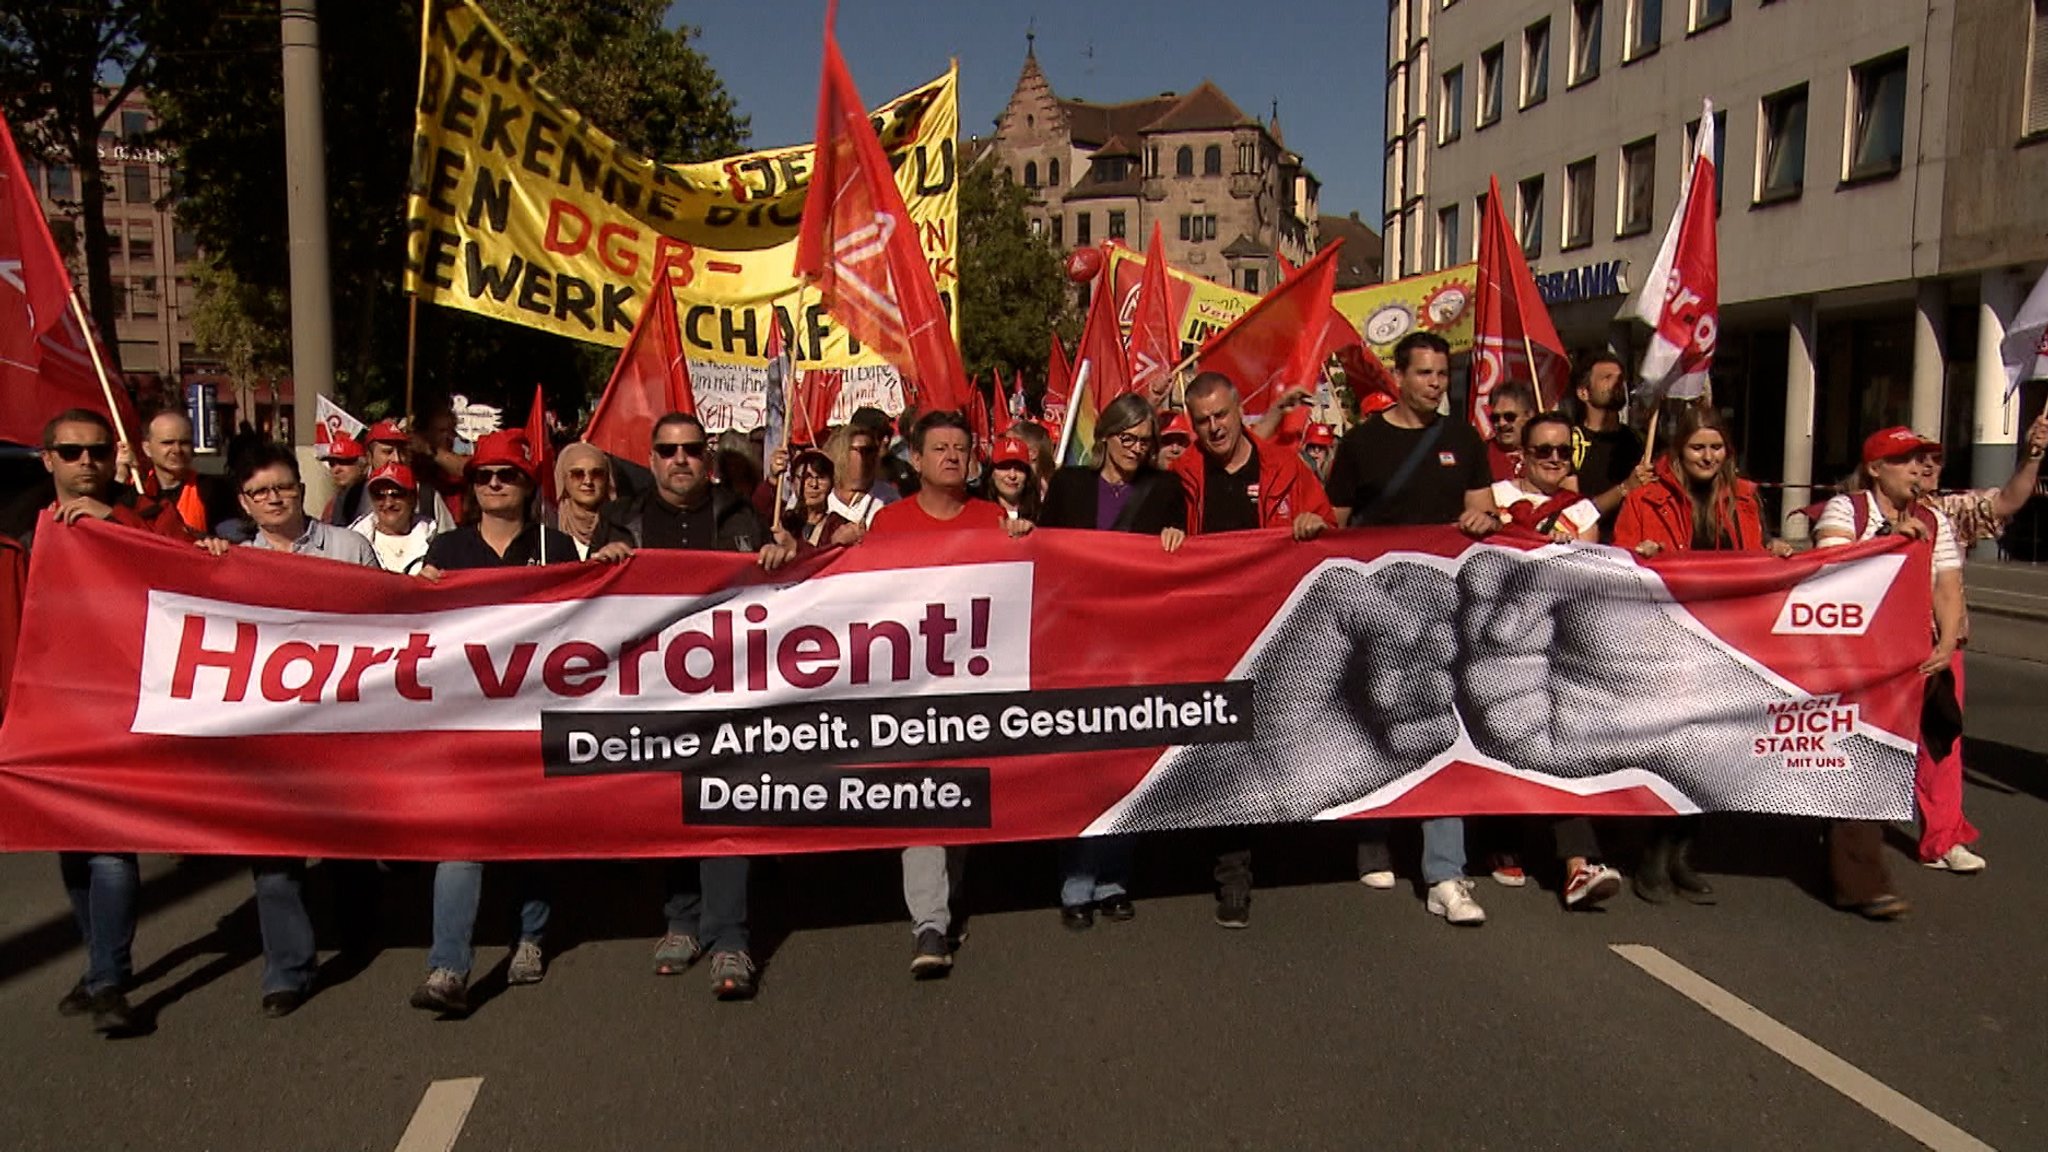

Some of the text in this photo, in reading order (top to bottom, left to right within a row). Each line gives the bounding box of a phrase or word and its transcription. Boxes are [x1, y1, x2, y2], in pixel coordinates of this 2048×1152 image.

[1790, 603, 1864, 628] DGB
[170, 596, 992, 703] Hart verdient!
[1766, 697, 1833, 715] MACH
[568, 691, 1239, 764] Deine Arbeit. Deine Gesundheit.
[1774, 710, 1853, 735] DICH
[1754, 736, 1825, 754] STARK
[1786, 757, 1846, 768] MIT UNS
[700, 773, 972, 811] Deine Rente.
